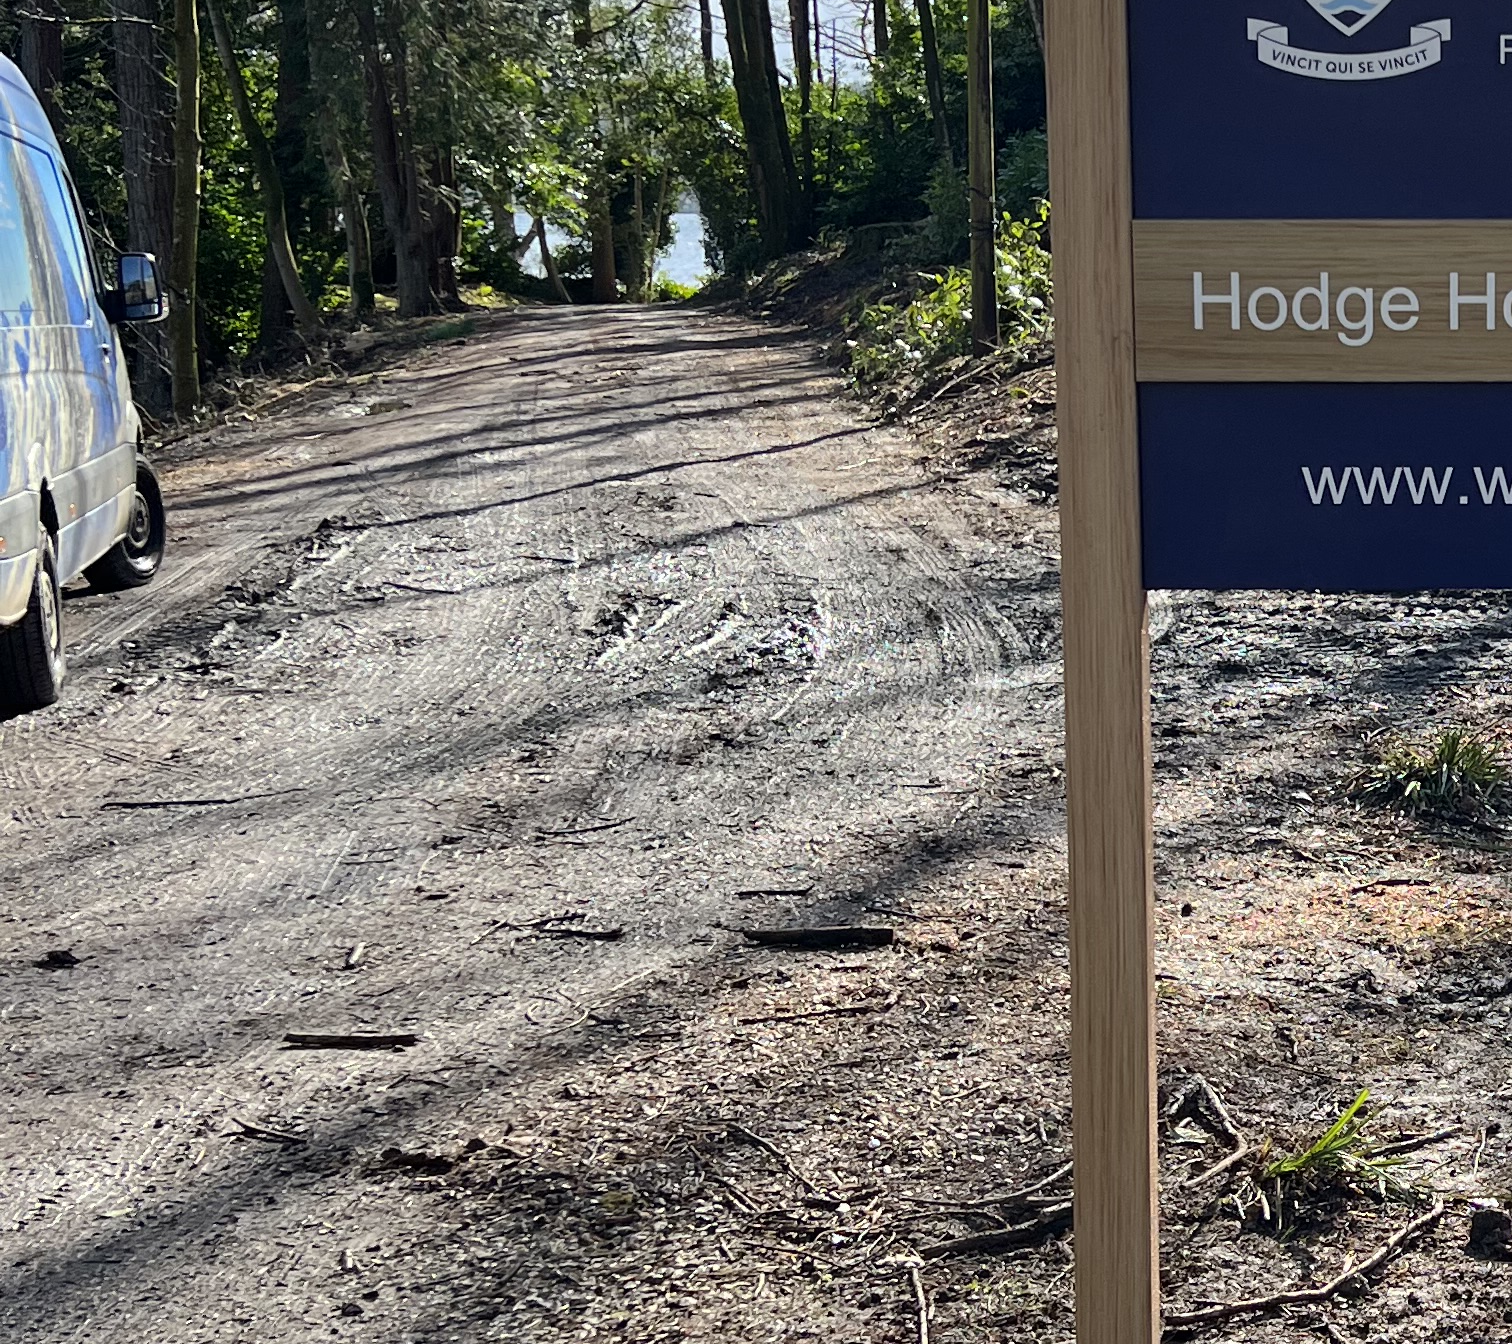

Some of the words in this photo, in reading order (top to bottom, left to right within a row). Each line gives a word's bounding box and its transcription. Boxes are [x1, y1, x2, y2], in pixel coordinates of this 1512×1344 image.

[1271, 48, 1322, 72] VINCIT
[1326, 61, 1353, 74] QUI
[1358, 61, 1375, 74] SE
[1379, 48, 1428, 72] VINCIT
[1194, 272, 1419, 345] Hodge
